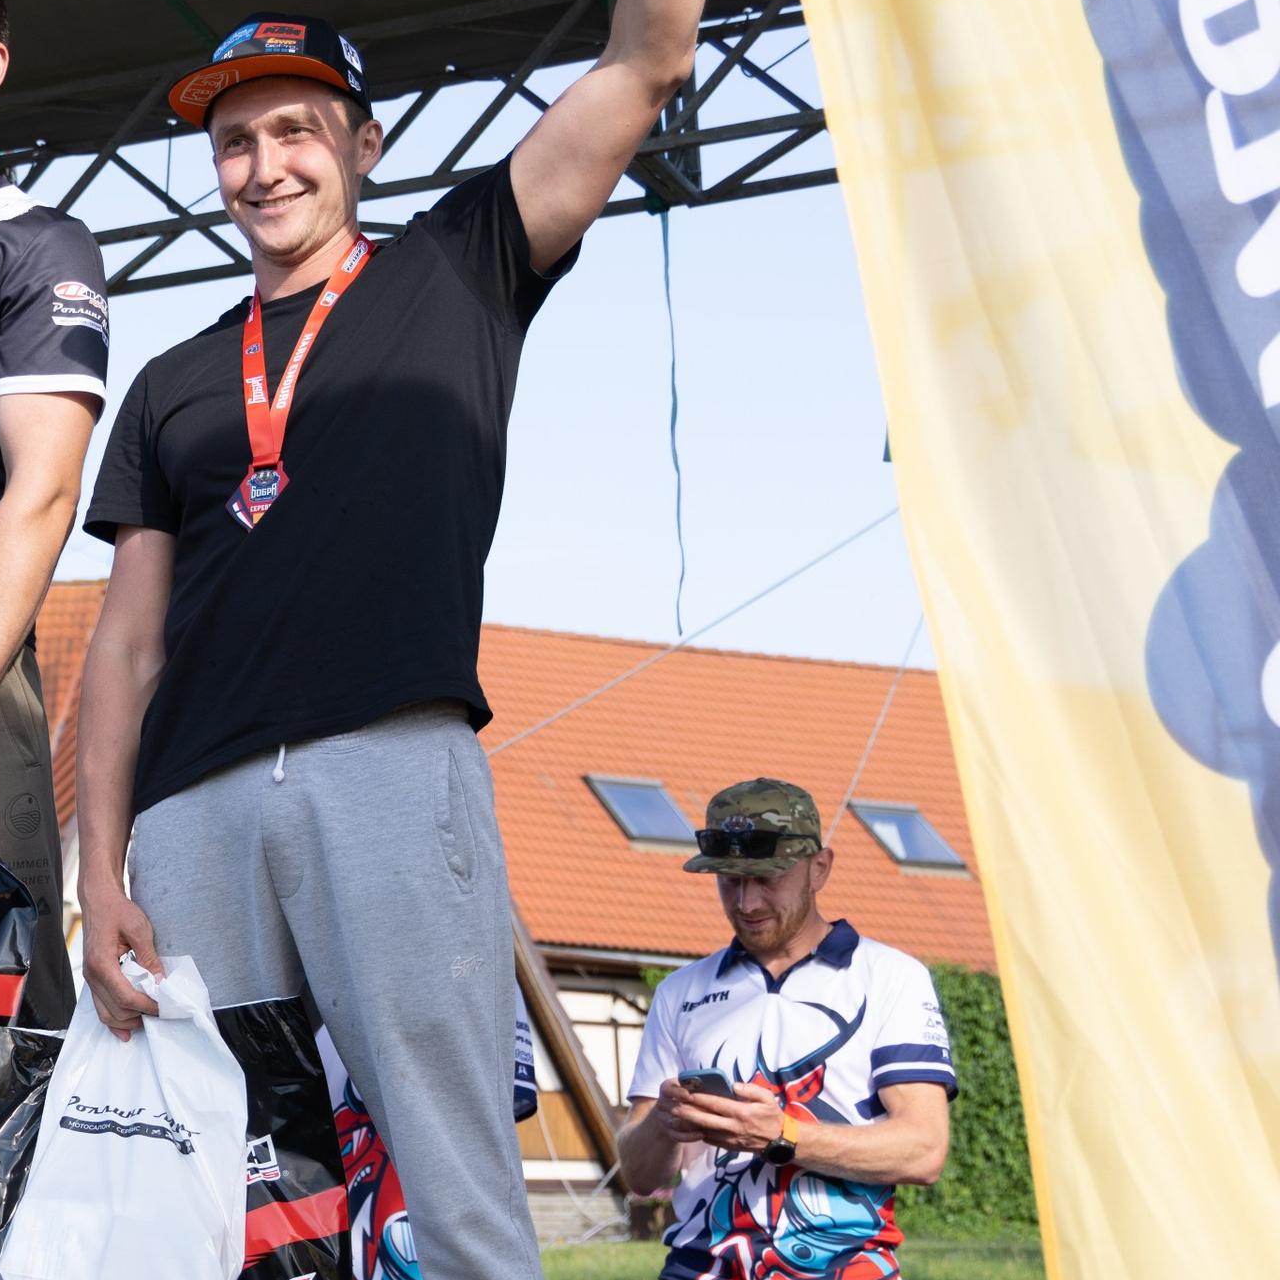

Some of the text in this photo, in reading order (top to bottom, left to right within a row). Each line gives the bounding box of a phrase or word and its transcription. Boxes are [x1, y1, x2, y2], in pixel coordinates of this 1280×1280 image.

[262, 26, 301, 36] KTM
[276, 332, 314, 409] HARD ENDURO
[250, 482, 278, 499] БОБРА
[8, 857, 49, 871] UMMER
[20, 874, 51, 886] RNEY
[68, 1120, 111, 1132] МОТОСАЛОН
